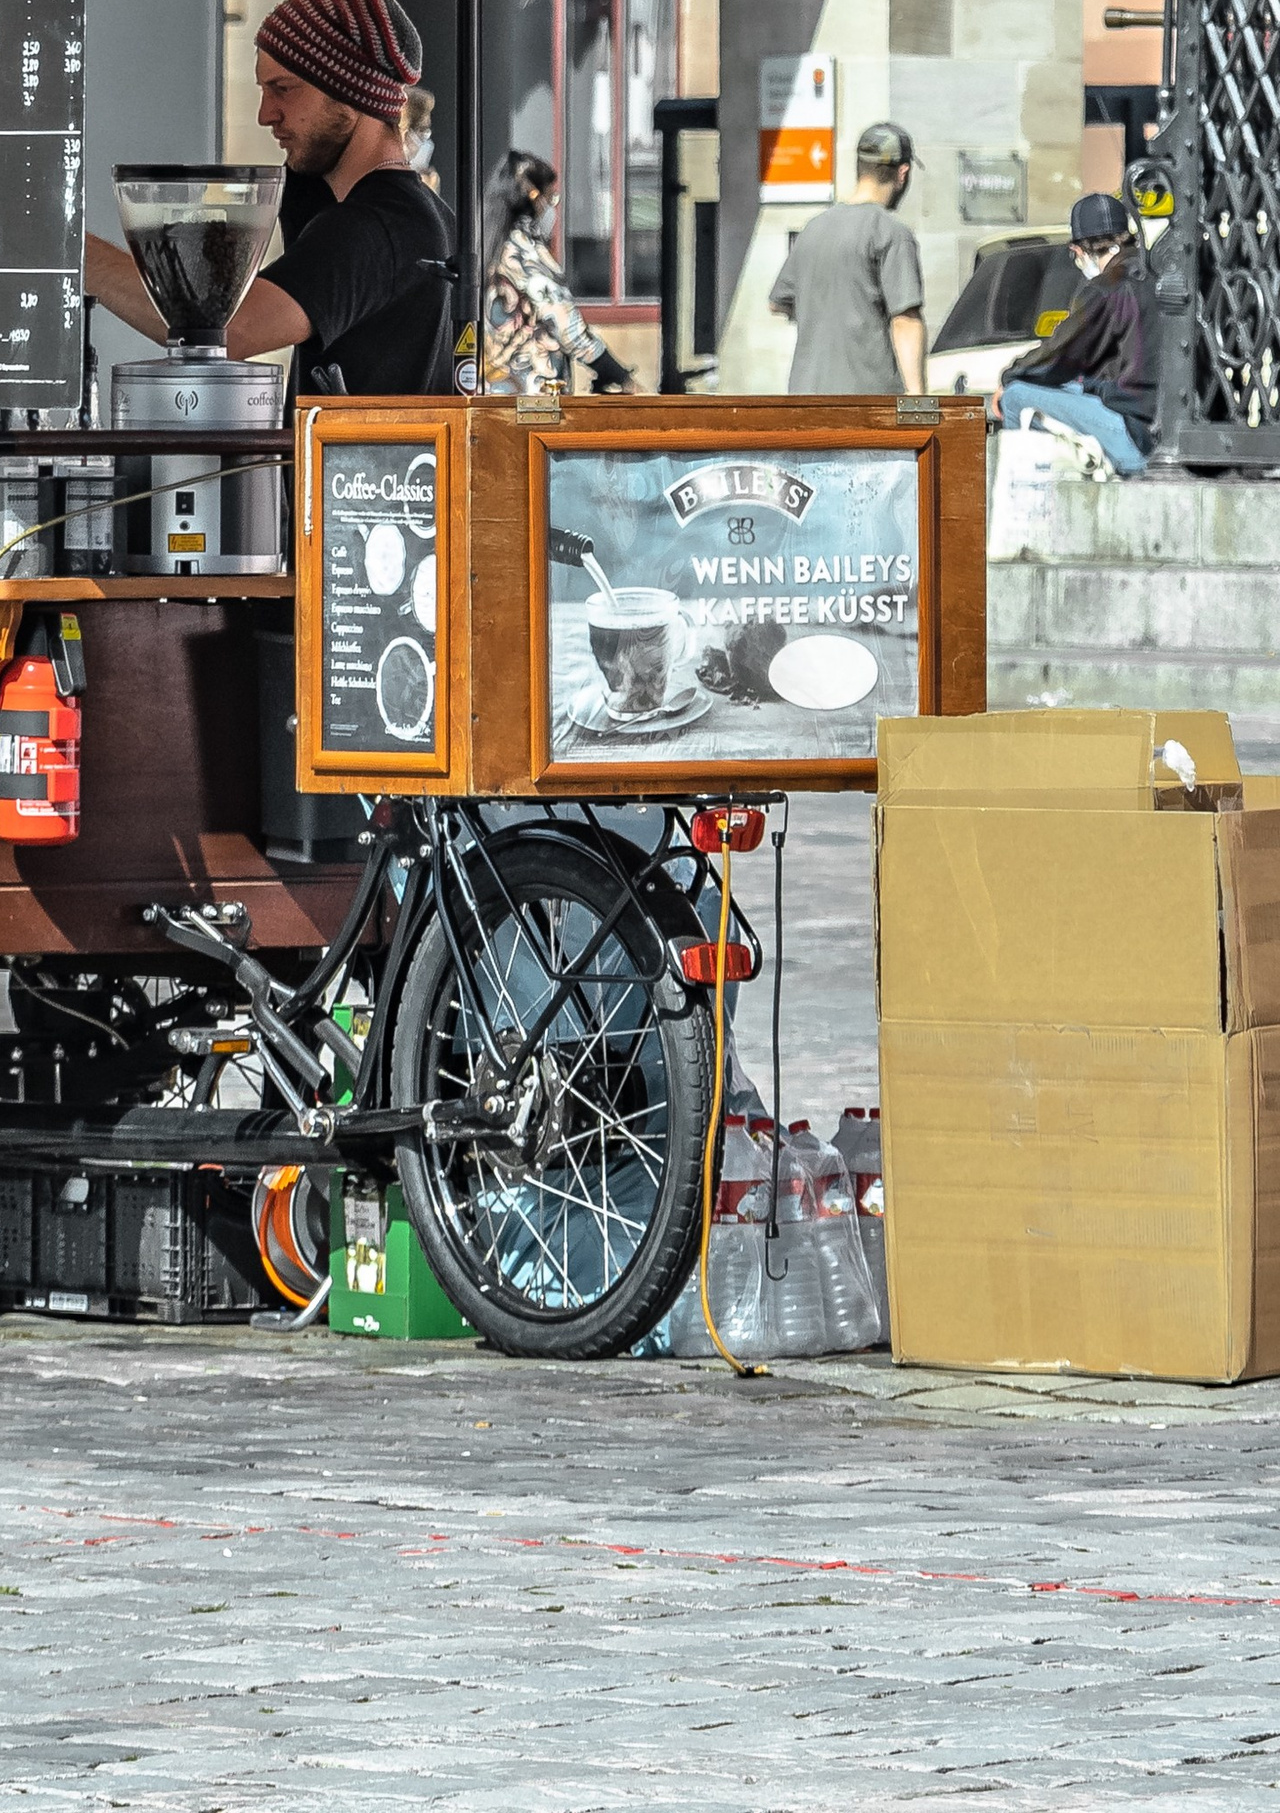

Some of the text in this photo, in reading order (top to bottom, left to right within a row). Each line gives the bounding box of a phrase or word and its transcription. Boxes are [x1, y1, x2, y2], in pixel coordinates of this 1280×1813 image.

[331, 472, 434, 503] Coffee-Classics
[678, 470, 809, 513] BILEYS
[691, 553, 913, 586] WENN BAILEYS
[699, 588, 909, 626] KAFFEE KÜSST
